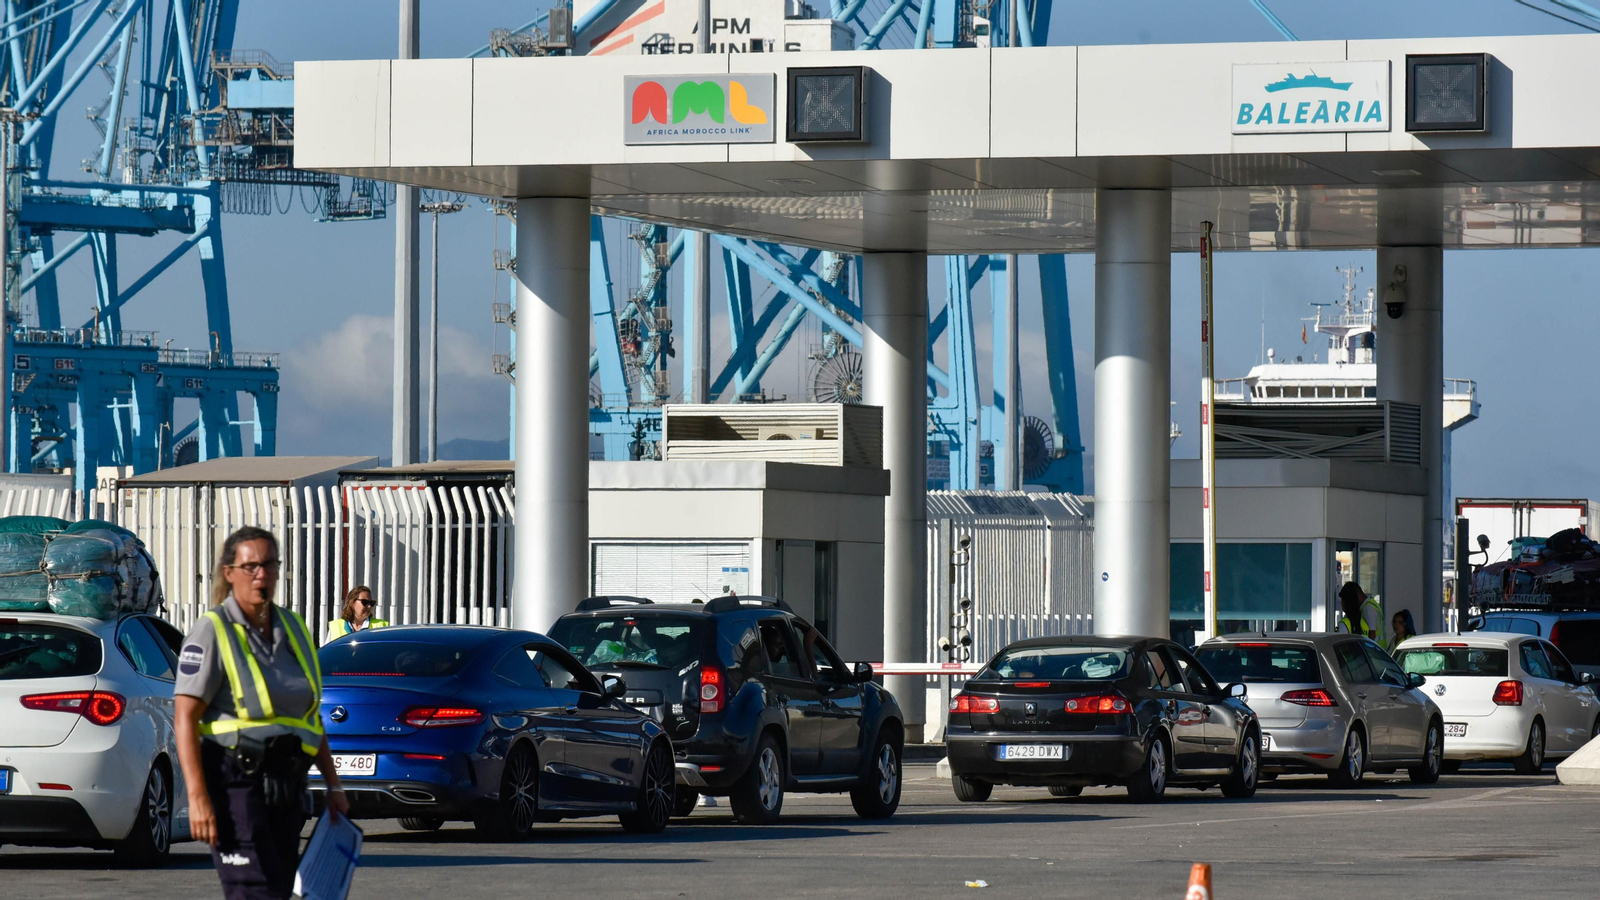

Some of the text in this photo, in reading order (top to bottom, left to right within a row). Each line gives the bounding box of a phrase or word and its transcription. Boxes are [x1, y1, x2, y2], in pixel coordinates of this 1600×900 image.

[632, 81, 767, 124] AML
[143, 363, 157, 372] 35
[264, 383, 277, 392] 37
[1008, 746, 1060, 757] 6429 DWX
